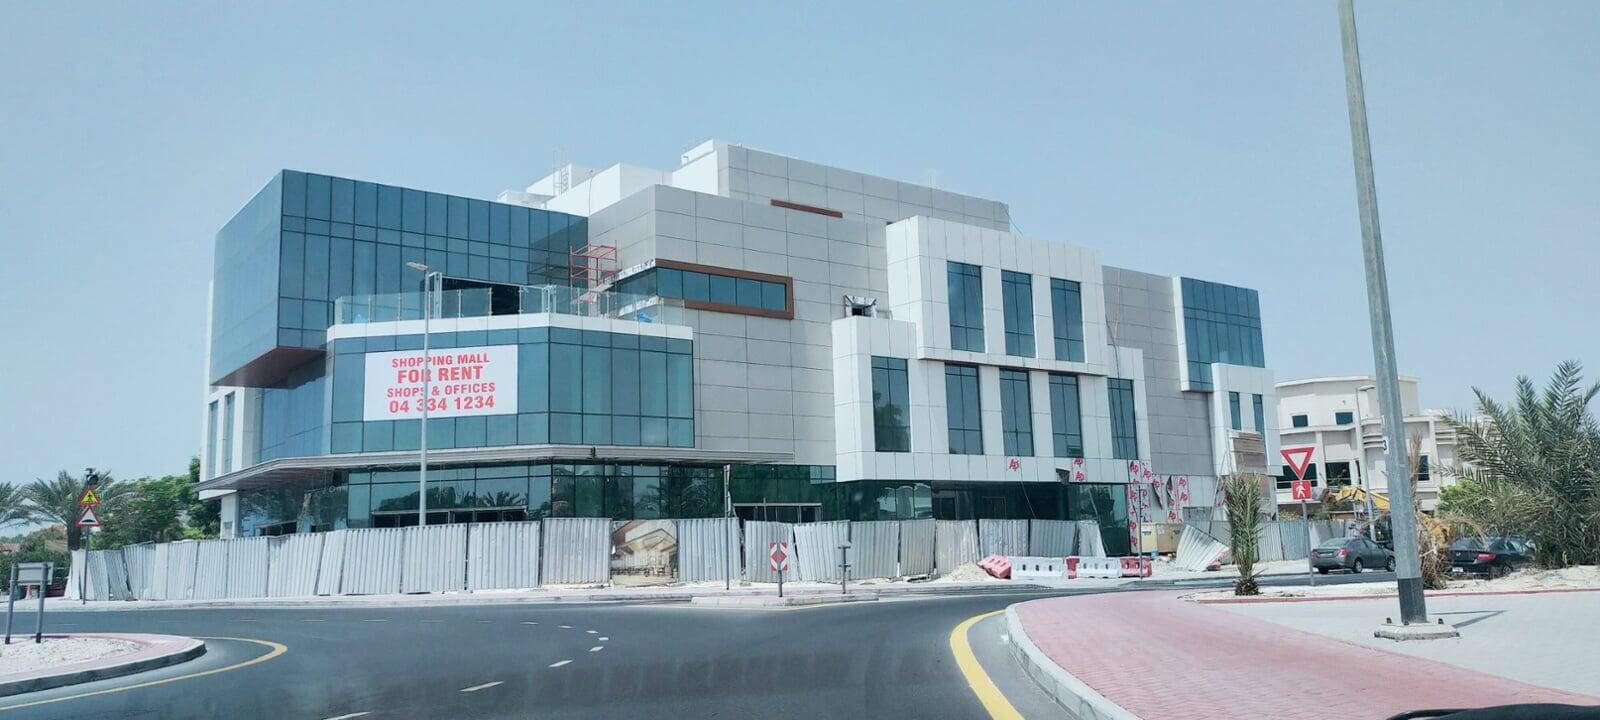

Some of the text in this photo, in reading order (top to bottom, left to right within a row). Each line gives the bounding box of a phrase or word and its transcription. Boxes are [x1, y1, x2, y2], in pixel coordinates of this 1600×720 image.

[392, 353, 490, 368] SHOPPING MALL
[397, 366, 483, 383] FOR RENT
[431, 386, 440, 396] &
[444, 382, 496, 395] OFFICES
[389, 396, 495, 413] 04 334 1234
